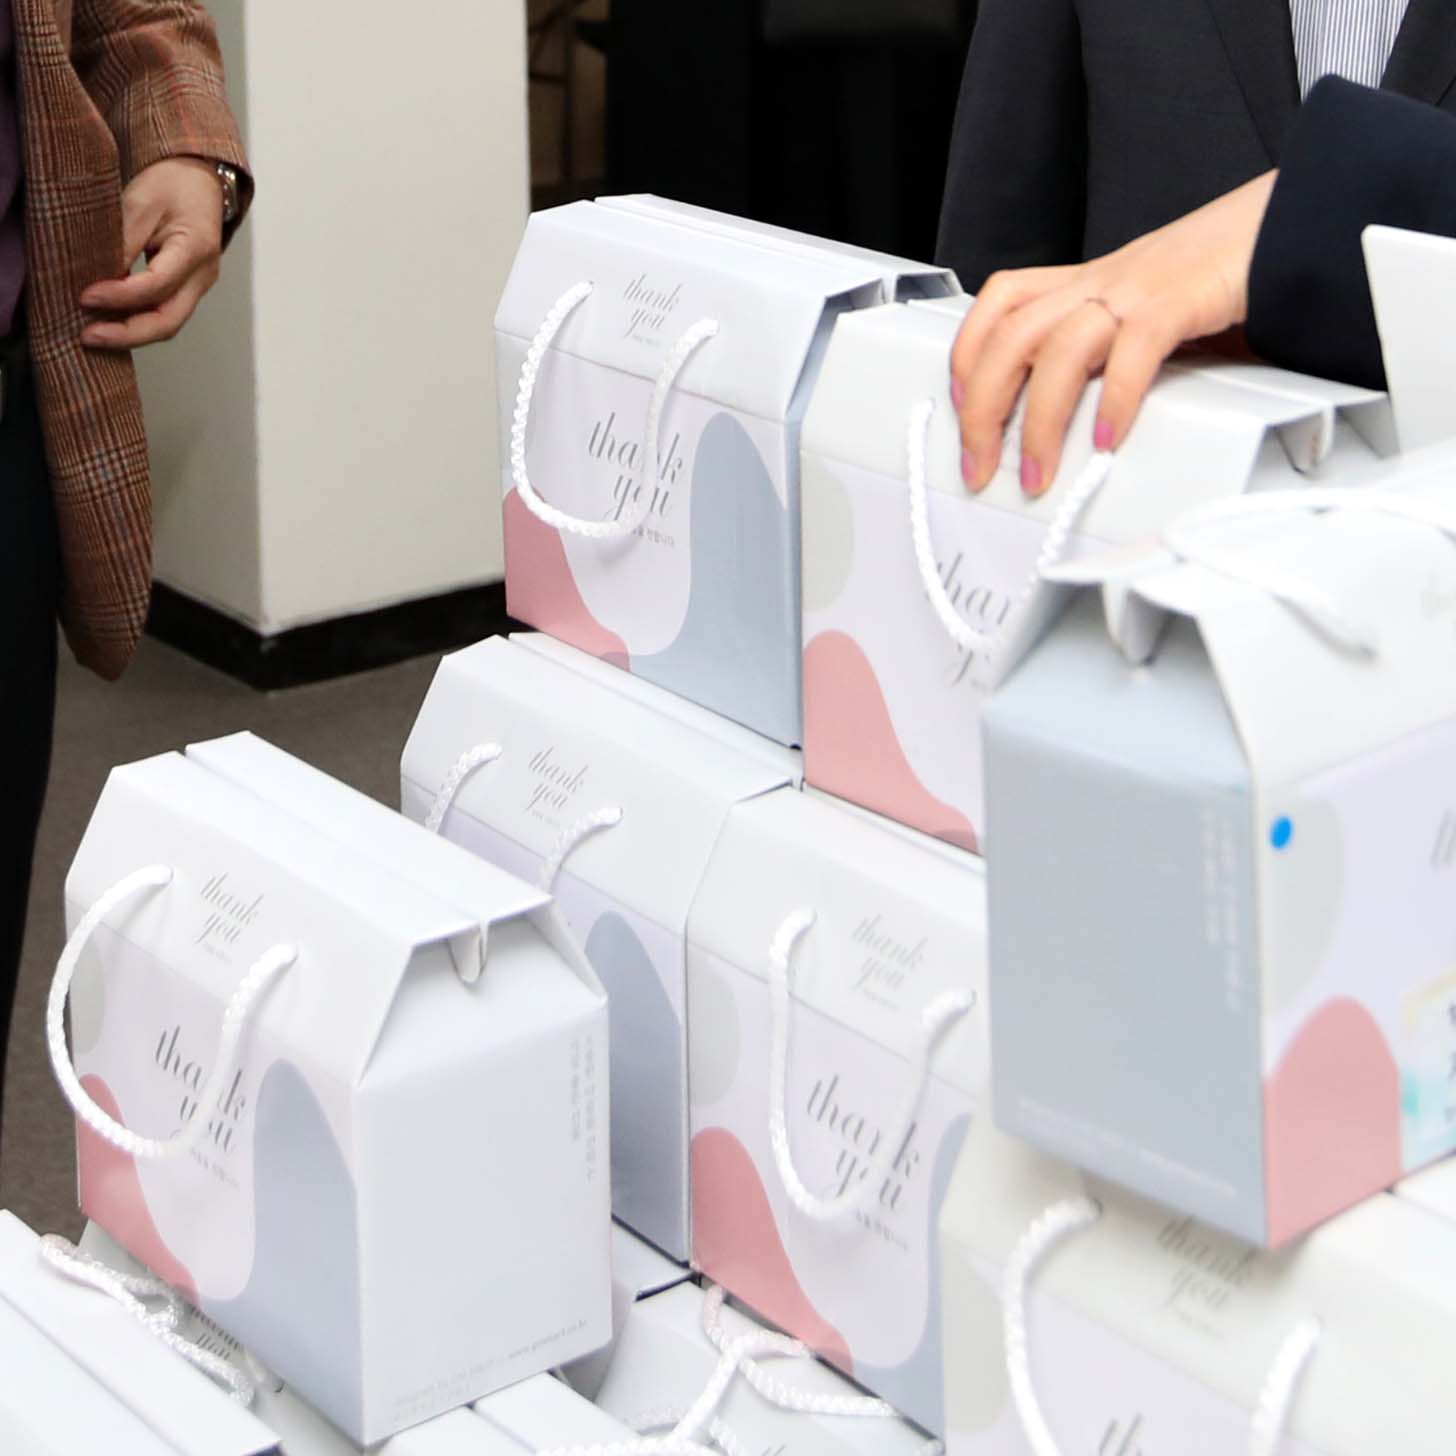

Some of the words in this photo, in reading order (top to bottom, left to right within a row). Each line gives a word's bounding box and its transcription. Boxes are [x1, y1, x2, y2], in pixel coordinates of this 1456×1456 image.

[624, 274, 682, 312] thank
[624, 309, 665, 338] you
[528, 746, 588, 793] thank
[524, 783, 568, 812] you
[199, 871, 264, 925] thank
[195, 913, 241, 944] you
[852, 913, 928, 969] thank
[852, 956, 905, 991] you
[155, 1025, 245, 1121] thak
[1160, 1263, 1231, 1310] you
